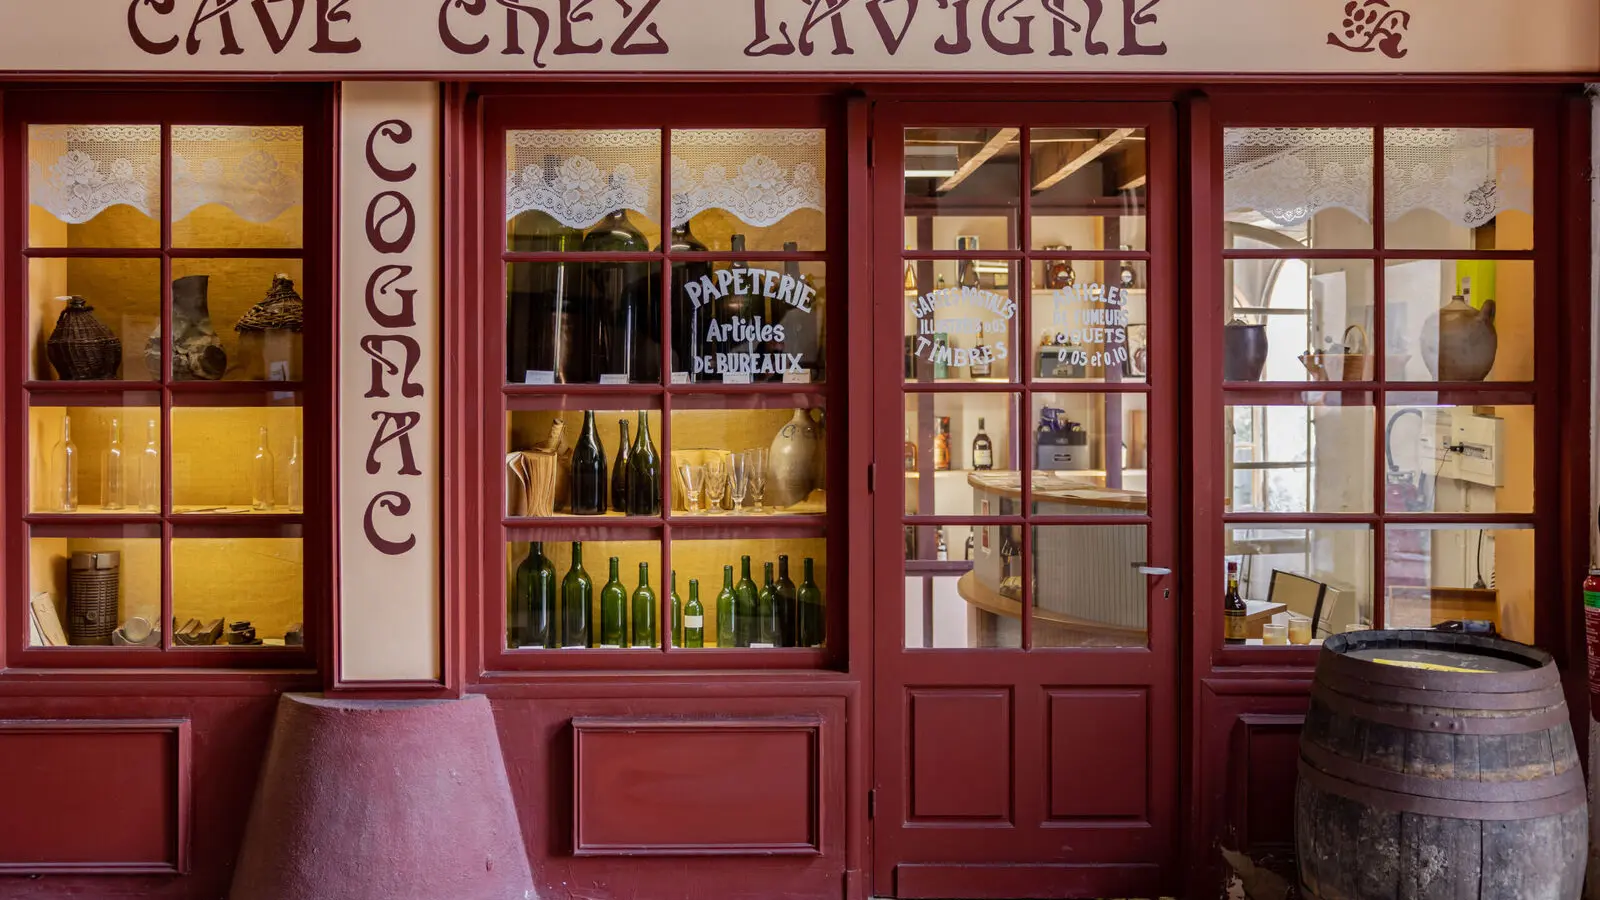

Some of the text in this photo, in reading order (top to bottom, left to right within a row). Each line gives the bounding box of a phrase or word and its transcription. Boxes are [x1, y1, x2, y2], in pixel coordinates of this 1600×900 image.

[127, 0, 361, 55] CAVE
[437, 0, 669, 69] CHEZ
[909, 285, 1017, 320] CARTES POSTALES
[1053, 282, 1129, 309] ARTICLES
[359, 118, 425, 556] COGNAC
[706, 315, 785, 342] Articles
[1056, 327, 1127, 344] JOUETS
[693, 352, 806, 374] DE BUREAUX
[914, 336, 1008, 367] TIMBRES
[1090, 351, 1102, 367] et
